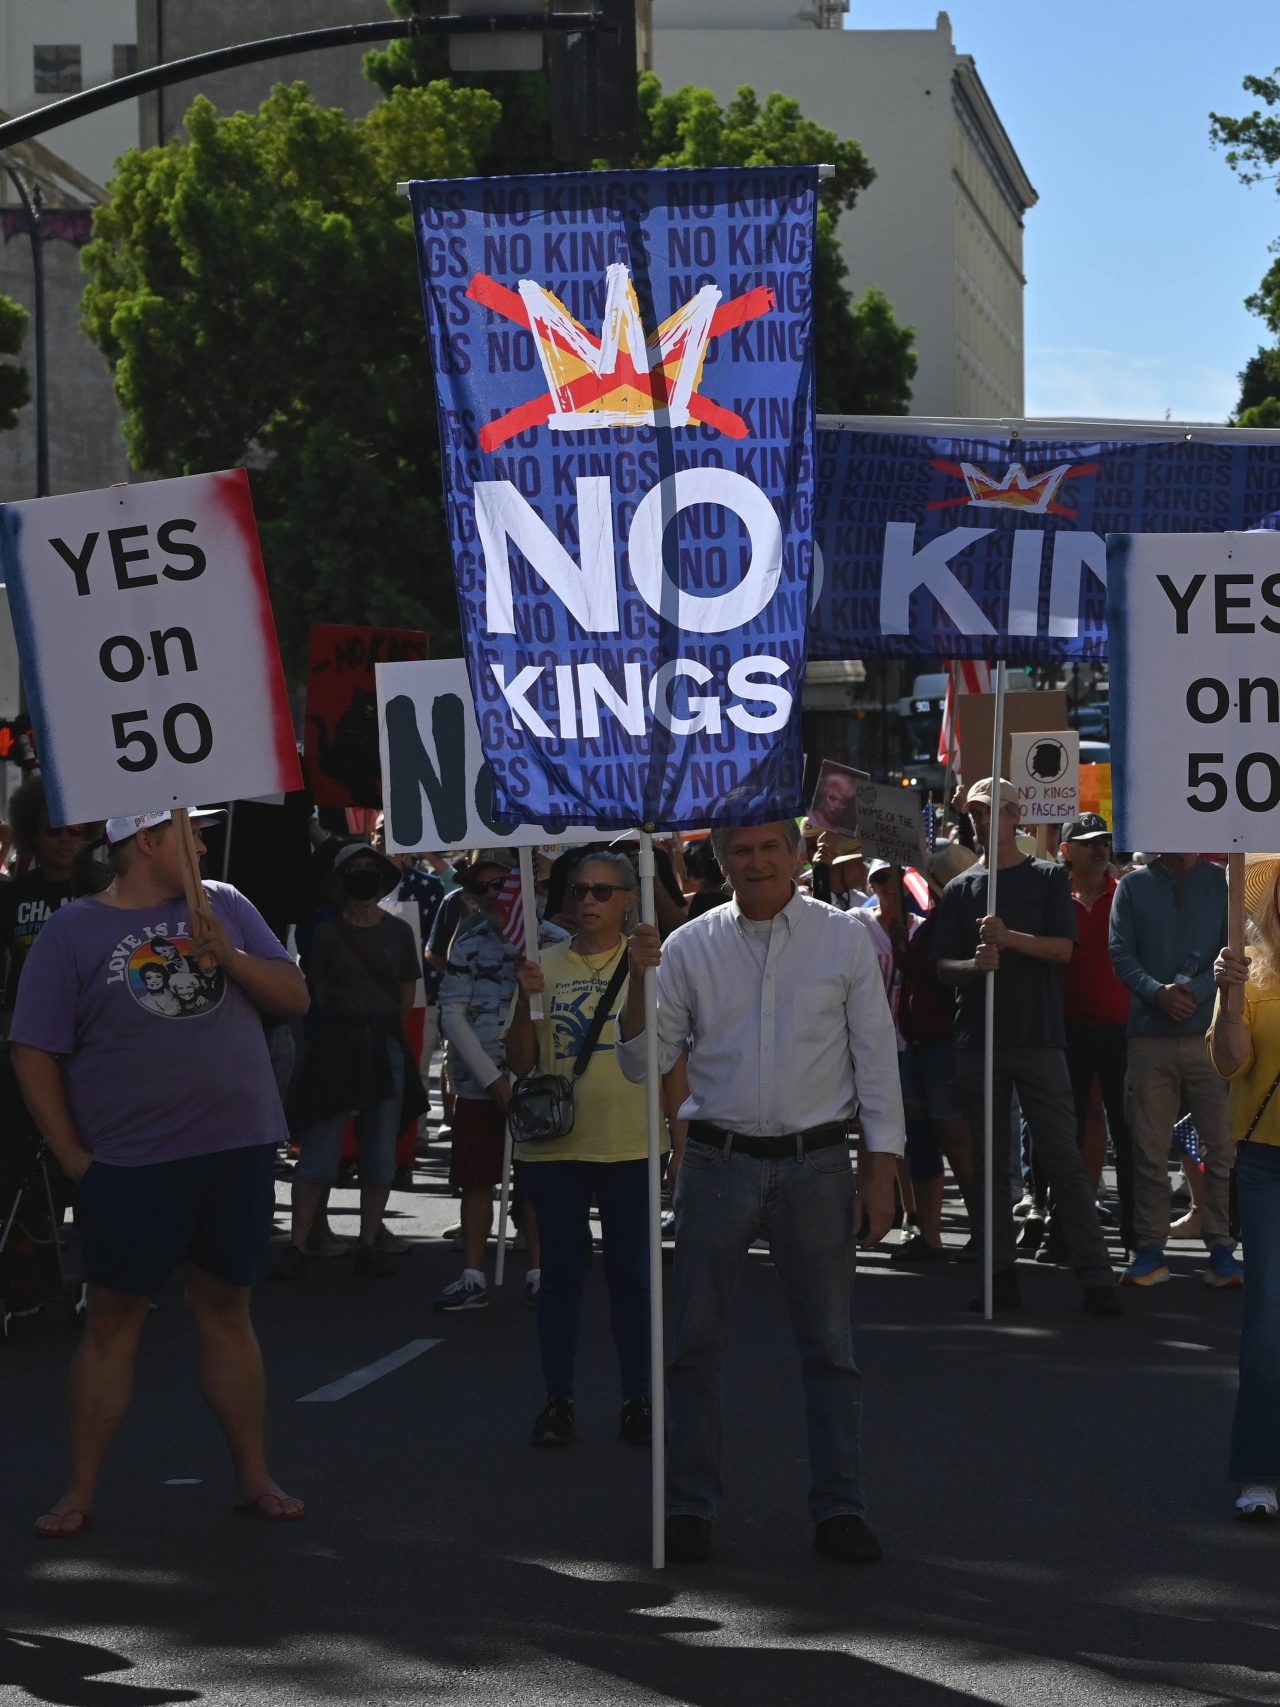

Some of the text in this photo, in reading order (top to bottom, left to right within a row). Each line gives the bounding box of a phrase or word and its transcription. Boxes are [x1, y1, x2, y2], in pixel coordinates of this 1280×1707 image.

[484, 234, 532, 275] NO
[544, 231, 650, 275] KINGS
[668, 226, 716, 267] NO
[48, 519, 207, 596] YES
[474, 467, 783, 634] NO
[99, 625, 198, 683] on
[490, 655, 792, 739] KINGS
[1186, 676, 1280, 724] on
[111, 702, 213, 773] 50
[1018, 787, 1036, 799] NO
[1032, 803, 1075, 817] FASCISM
[107, 934, 143, 984] LOVE
[142, 921, 168, 938] IS
